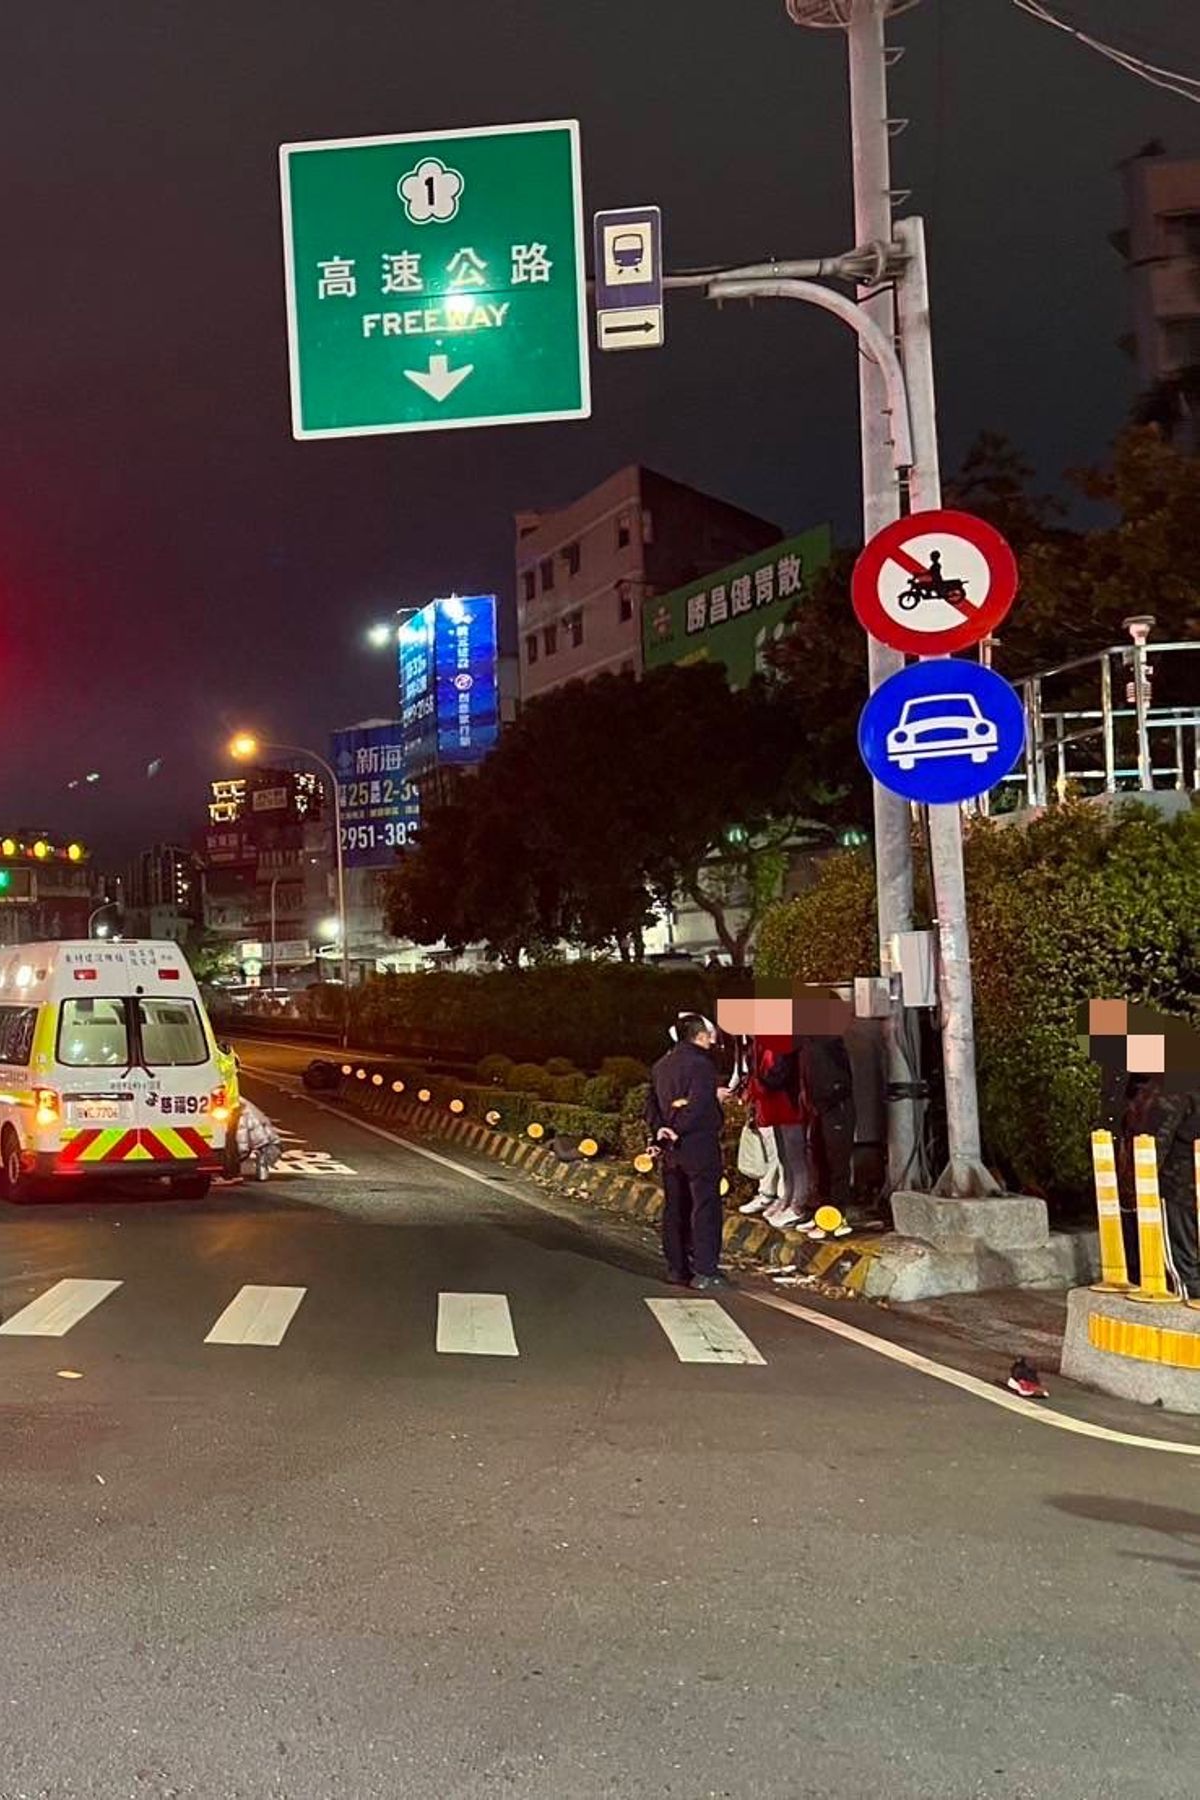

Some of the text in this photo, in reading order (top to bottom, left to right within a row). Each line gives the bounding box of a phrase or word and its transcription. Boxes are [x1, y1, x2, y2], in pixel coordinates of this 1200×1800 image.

[425, 177, 435, 206] 1
[316, 242, 554, 300] 高速公路
[362, 302, 510, 338] FREEWAY
[687, 553, 802, 633] 勝昌健胃散
